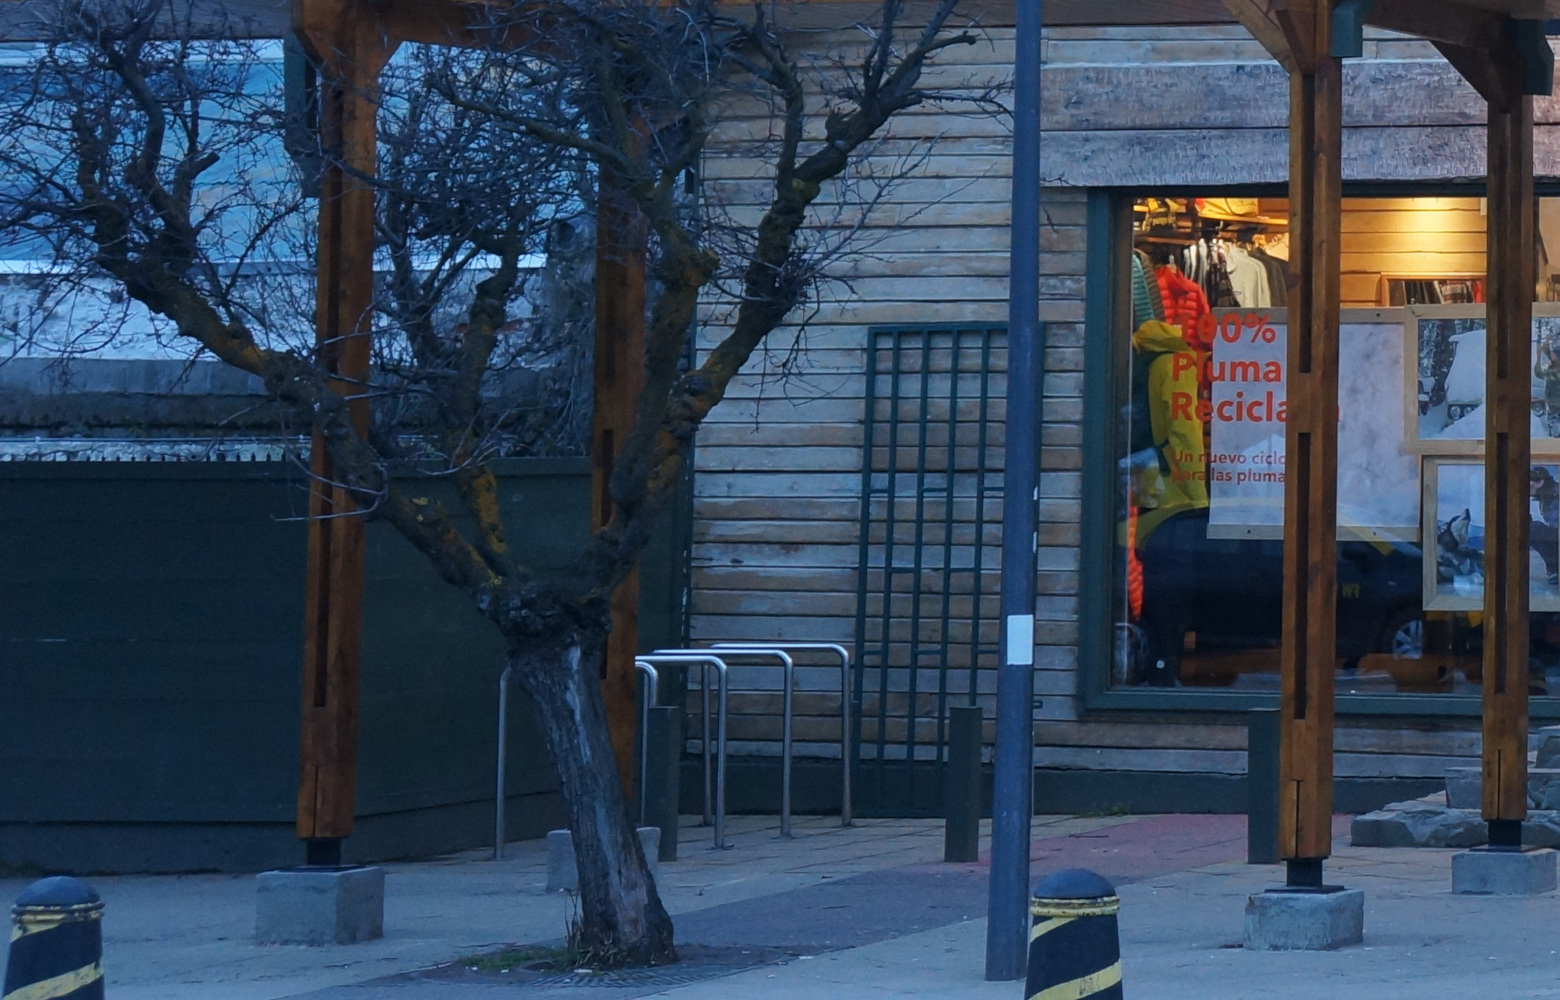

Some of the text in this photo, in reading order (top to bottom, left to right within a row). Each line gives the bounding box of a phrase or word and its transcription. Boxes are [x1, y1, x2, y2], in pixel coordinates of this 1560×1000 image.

[1172, 351, 1282, 382] Pluma
[1174, 450, 1193, 463] Un
[1199, 453, 1247, 465] nuevo
[1211, 467, 1233, 482] las
